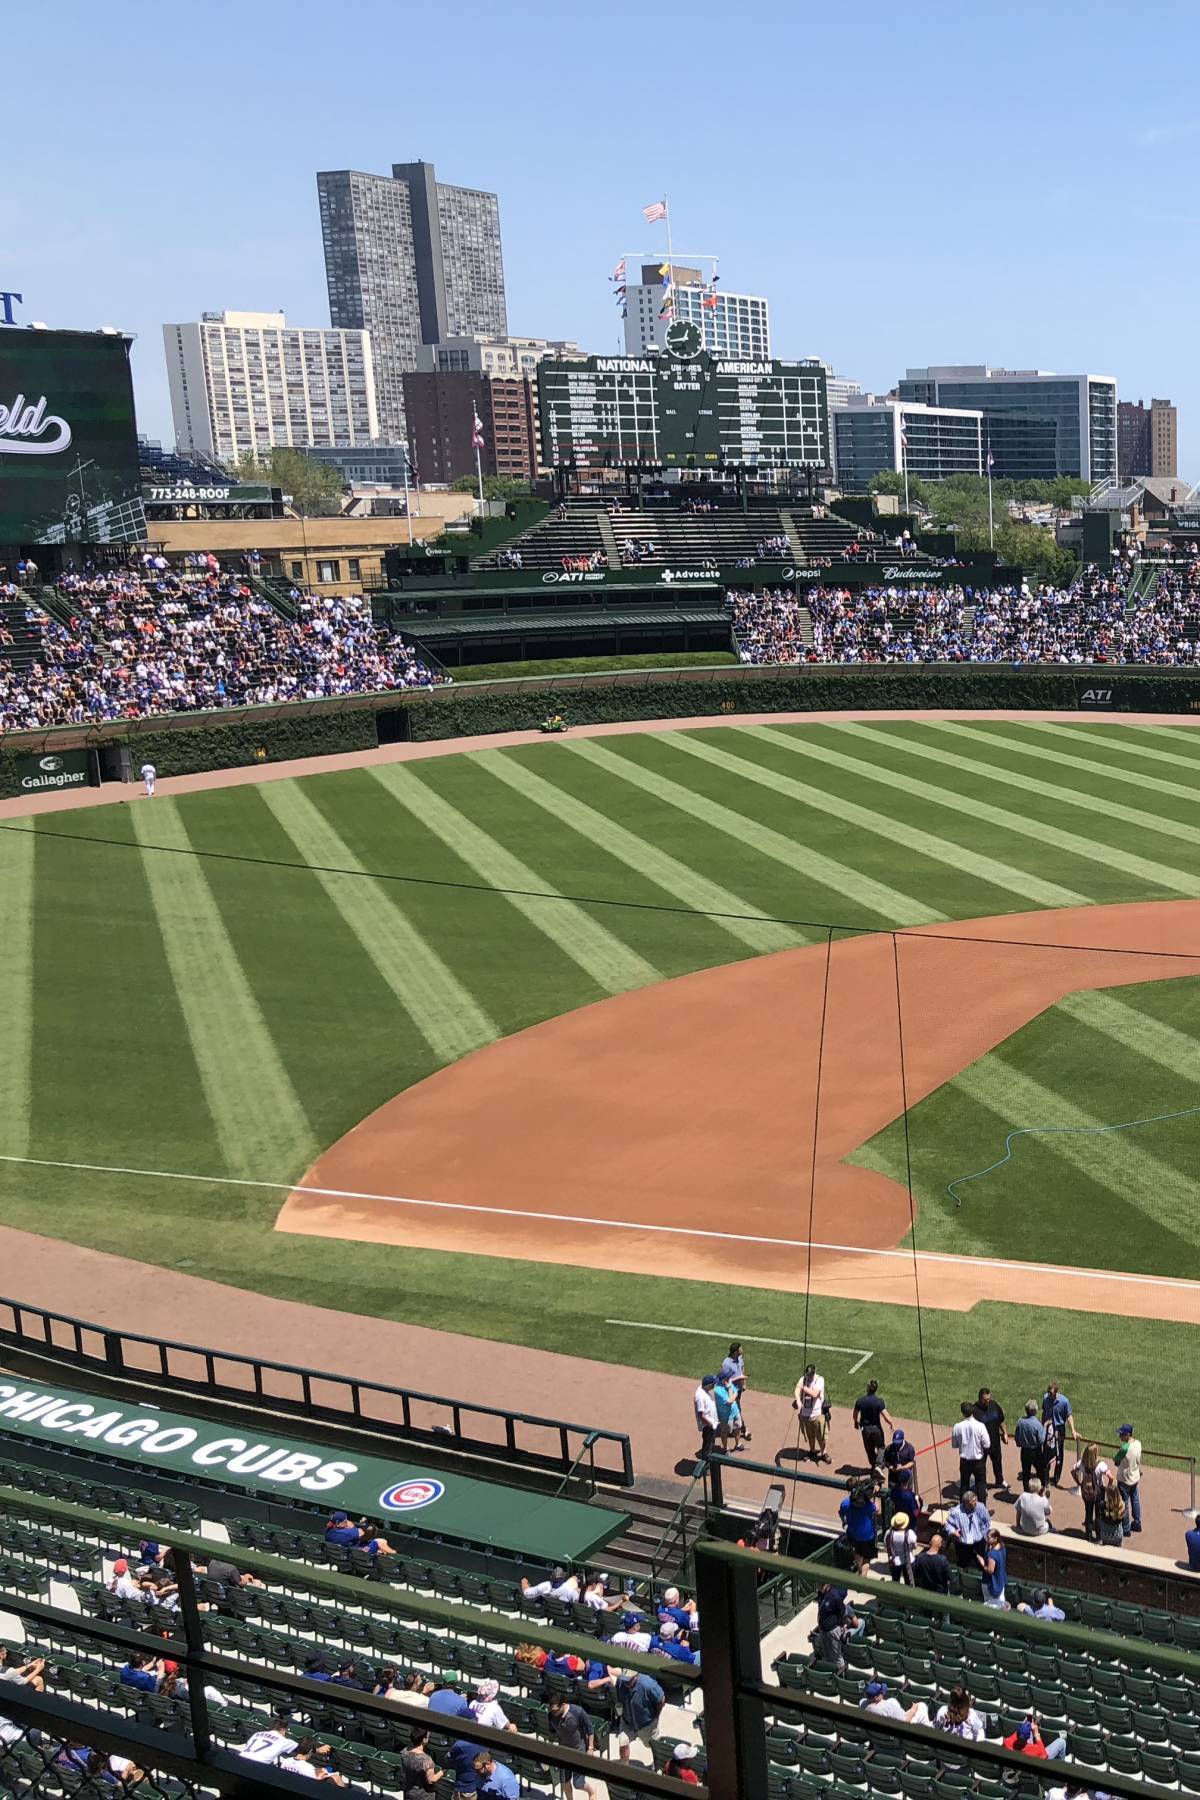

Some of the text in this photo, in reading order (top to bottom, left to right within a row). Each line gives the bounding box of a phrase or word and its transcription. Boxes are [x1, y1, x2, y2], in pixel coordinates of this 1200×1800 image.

[597, 359, 656, 372] NATIONAL
[716, 362, 772, 374] AMERICAN
[674, 382, 700, 390] BATTER
[150, 488, 230, 499] 773-248-ROOF
[558, 572, 584, 581] ATI
[675, 569, 720, 578] Advocate
[795, 569, 820, 580] pepsi
[882, 566, 944, 580] Budweiser
[1081, 690, 1112, 700] ATI
[22, 772, 85, 788] Gallagher
[191, 1438, 359, 1490] CUBS
[244, 1739, 273, 1752] 17
